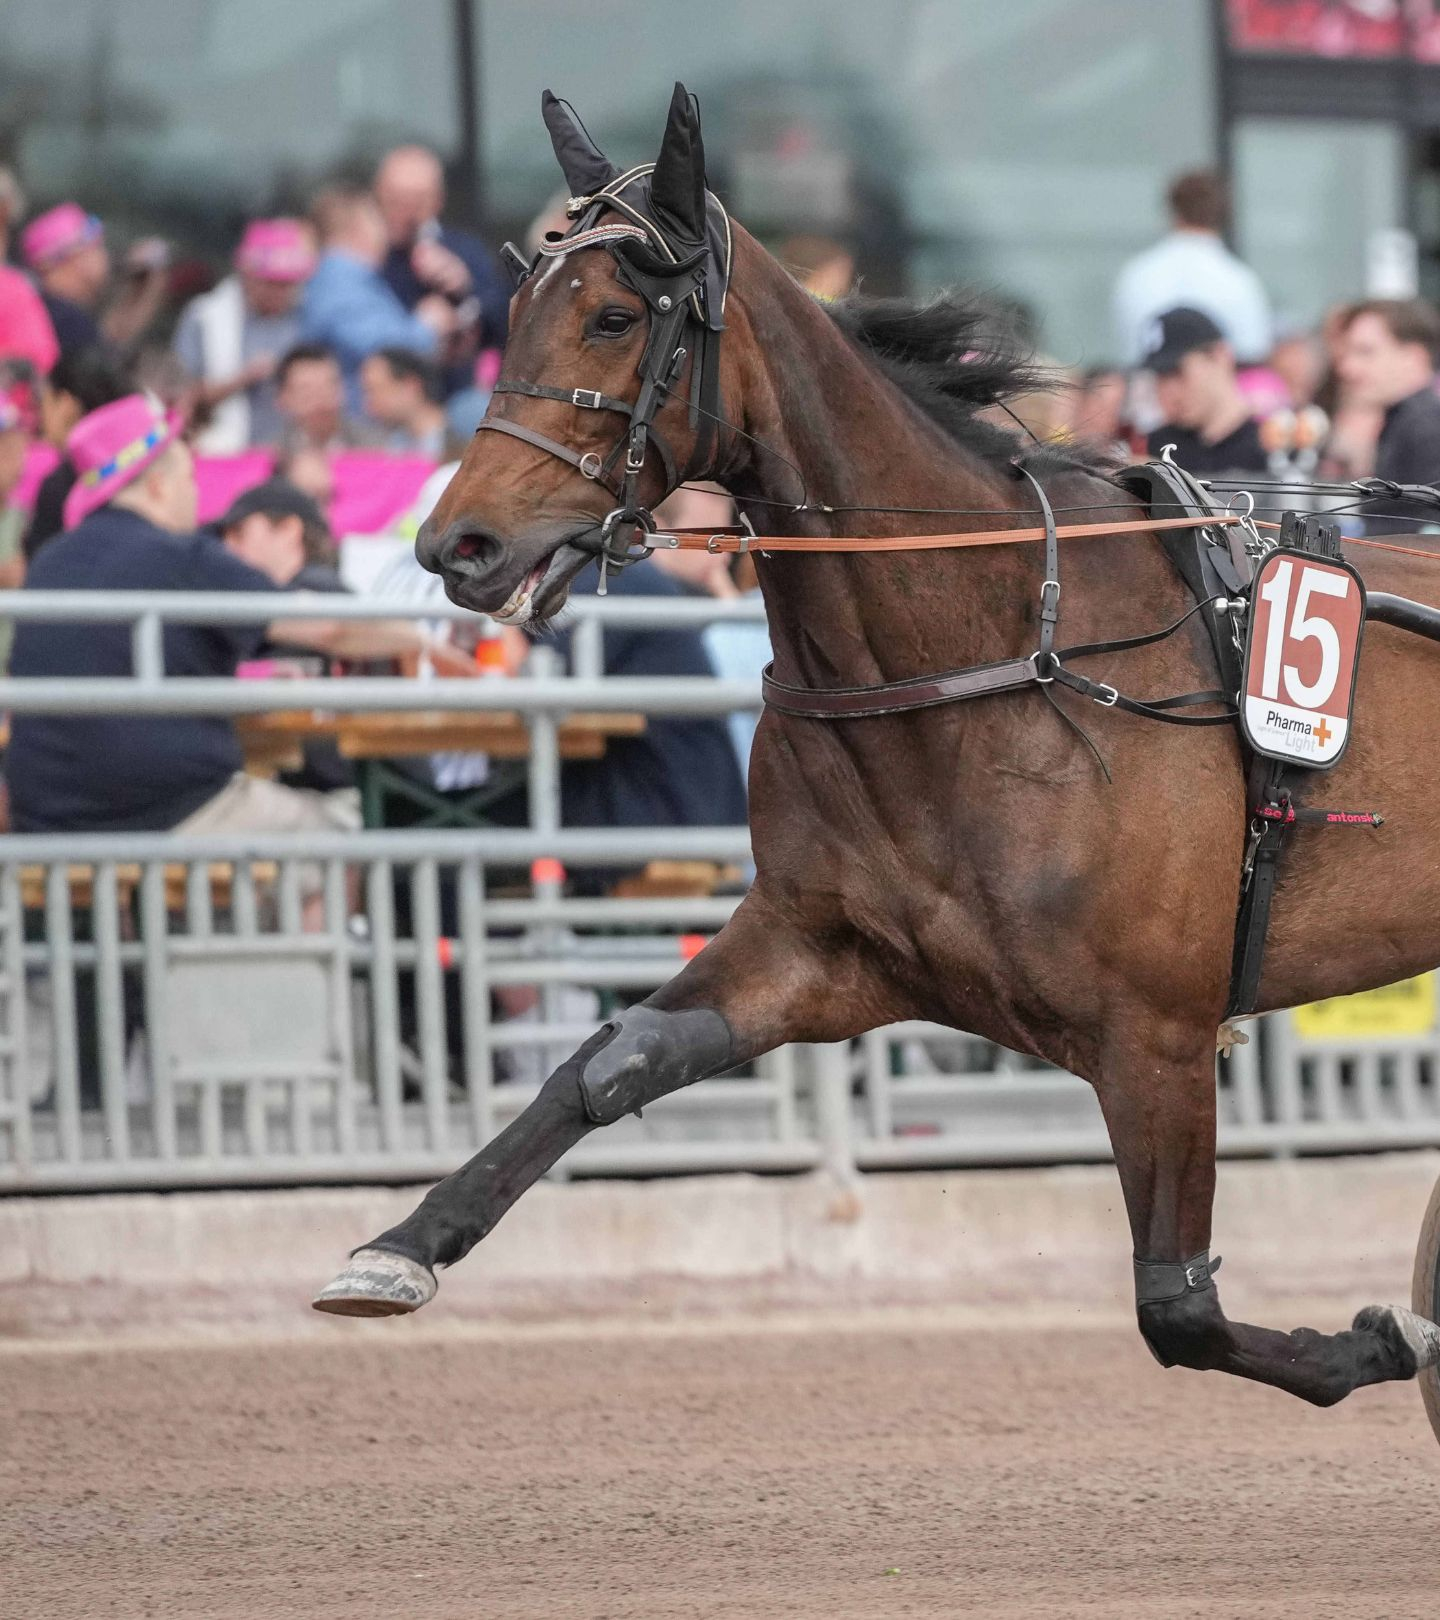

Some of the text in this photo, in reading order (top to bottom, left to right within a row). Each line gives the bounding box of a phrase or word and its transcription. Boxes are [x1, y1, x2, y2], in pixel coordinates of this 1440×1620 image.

[1261, 560, 1350, 709] 15
[1266, 710, 1312, 736] Pharma
[1285, 733, 1316, 752] Light
